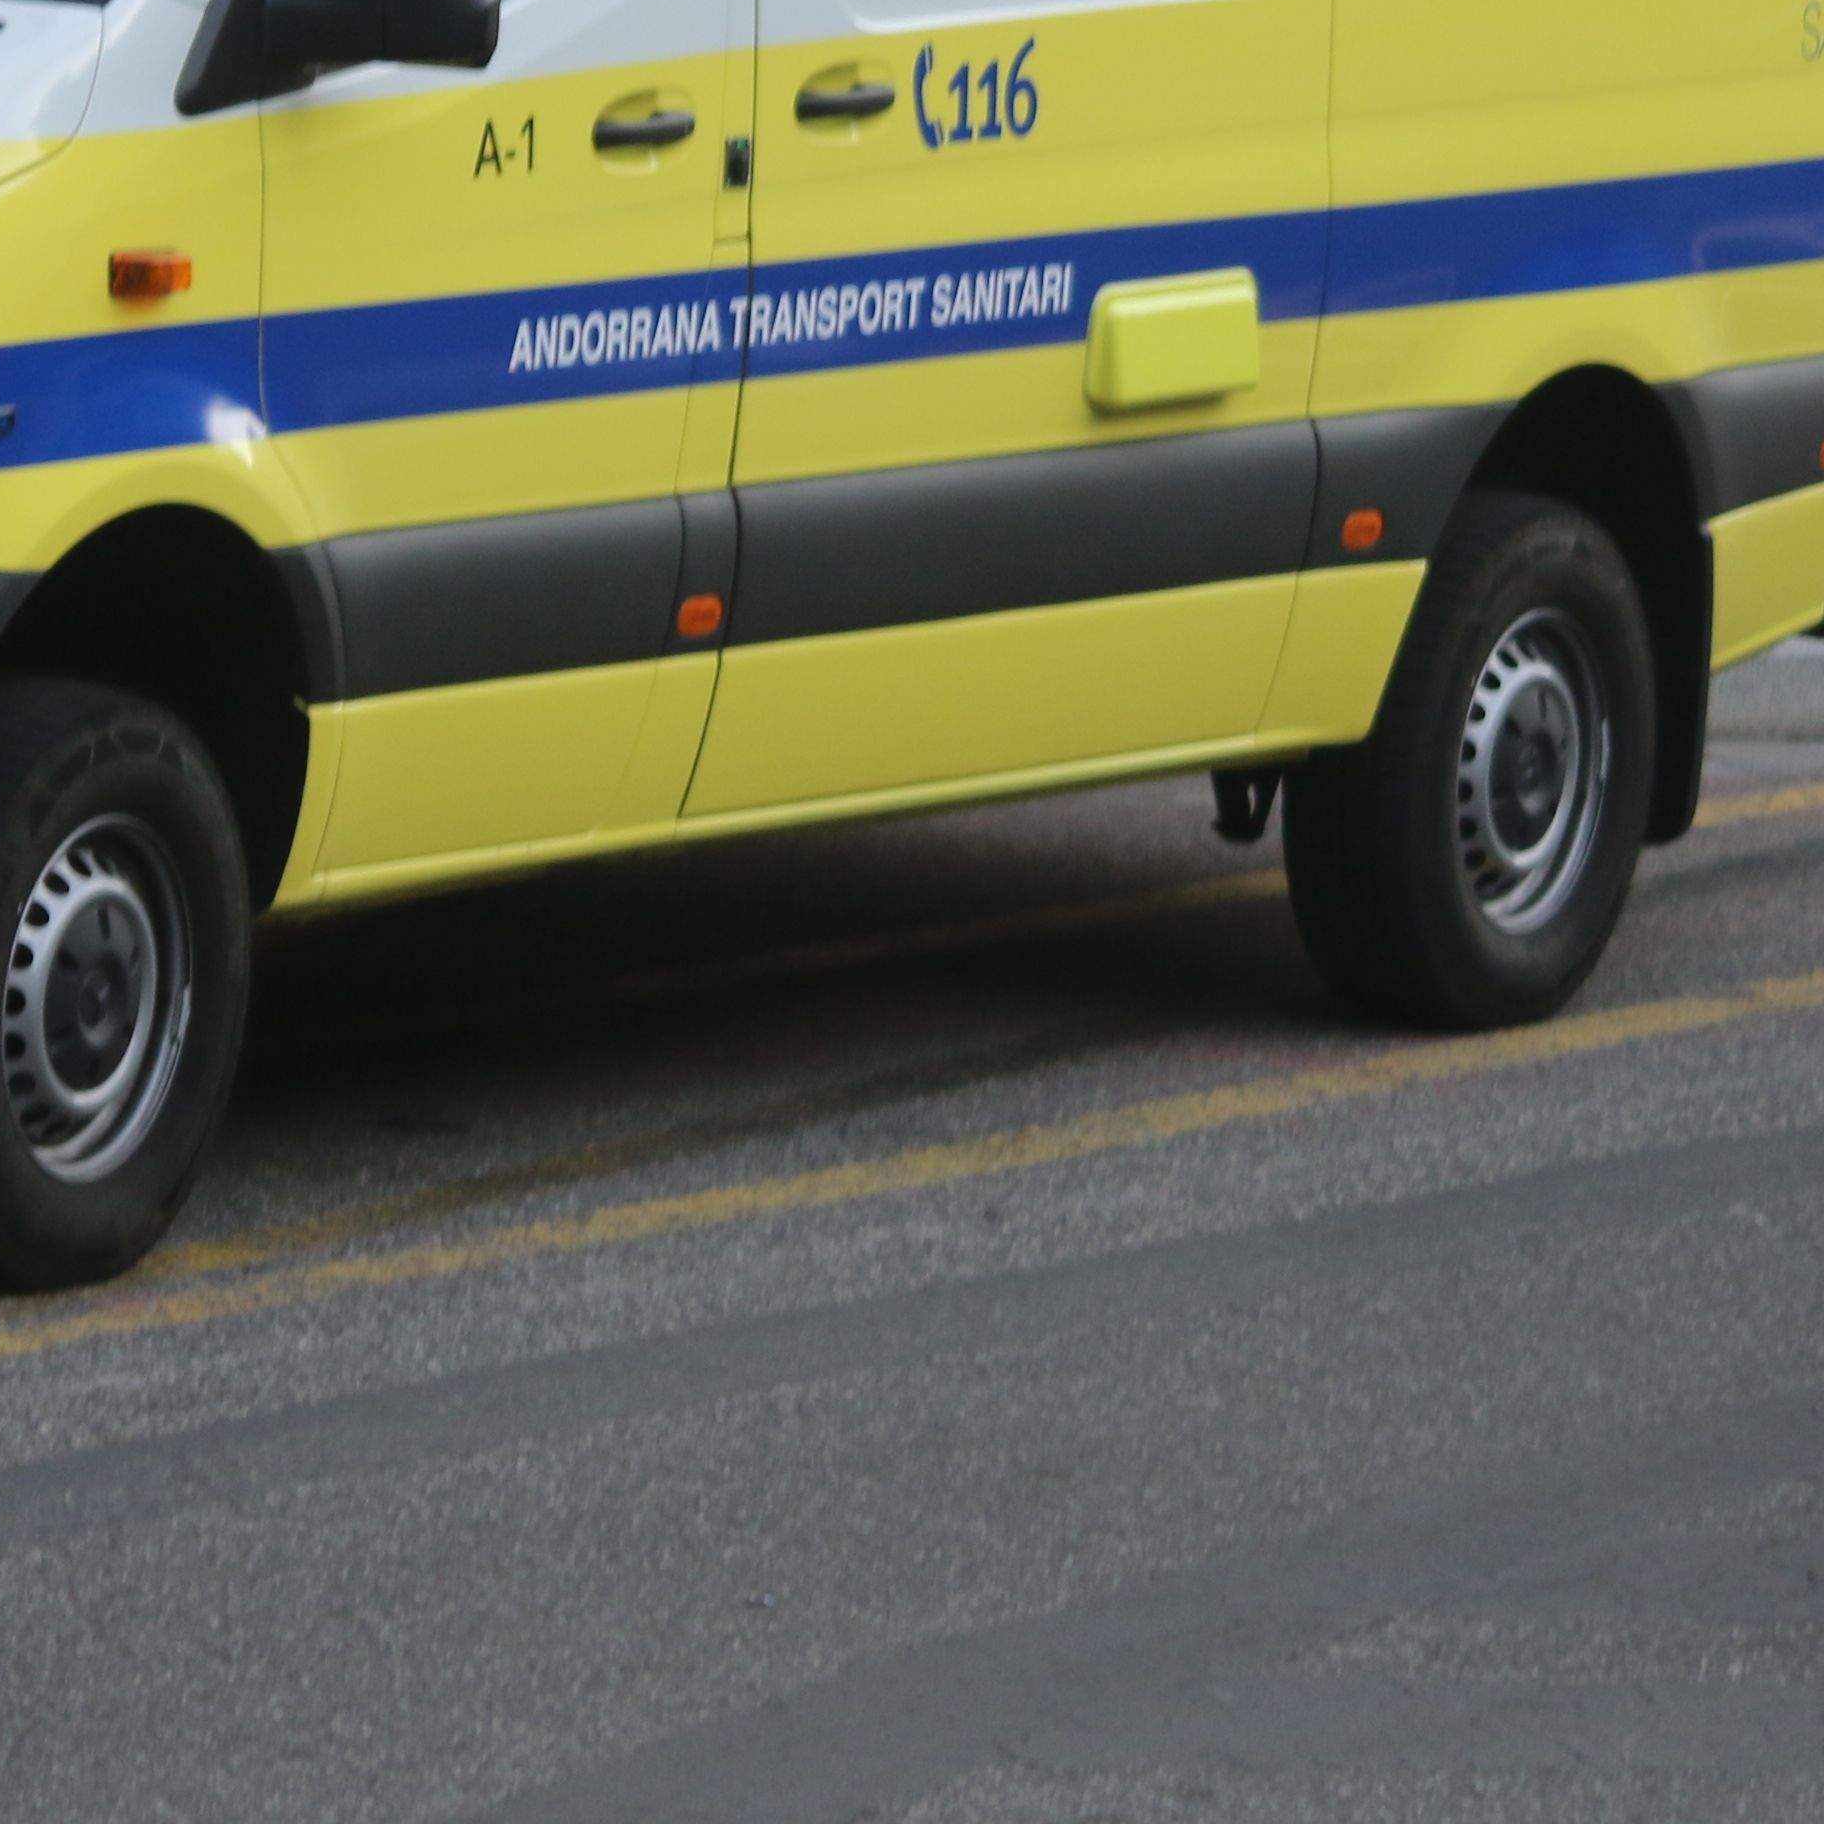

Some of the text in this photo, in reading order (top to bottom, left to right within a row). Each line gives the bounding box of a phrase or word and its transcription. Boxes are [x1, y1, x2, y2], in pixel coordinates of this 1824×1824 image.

[947, 36, 1037, 142] 116
[474, 115, 535, 176] A-1
[507, 263, 1073, 373] ANDORRANA TRANSPORT SANITARI
